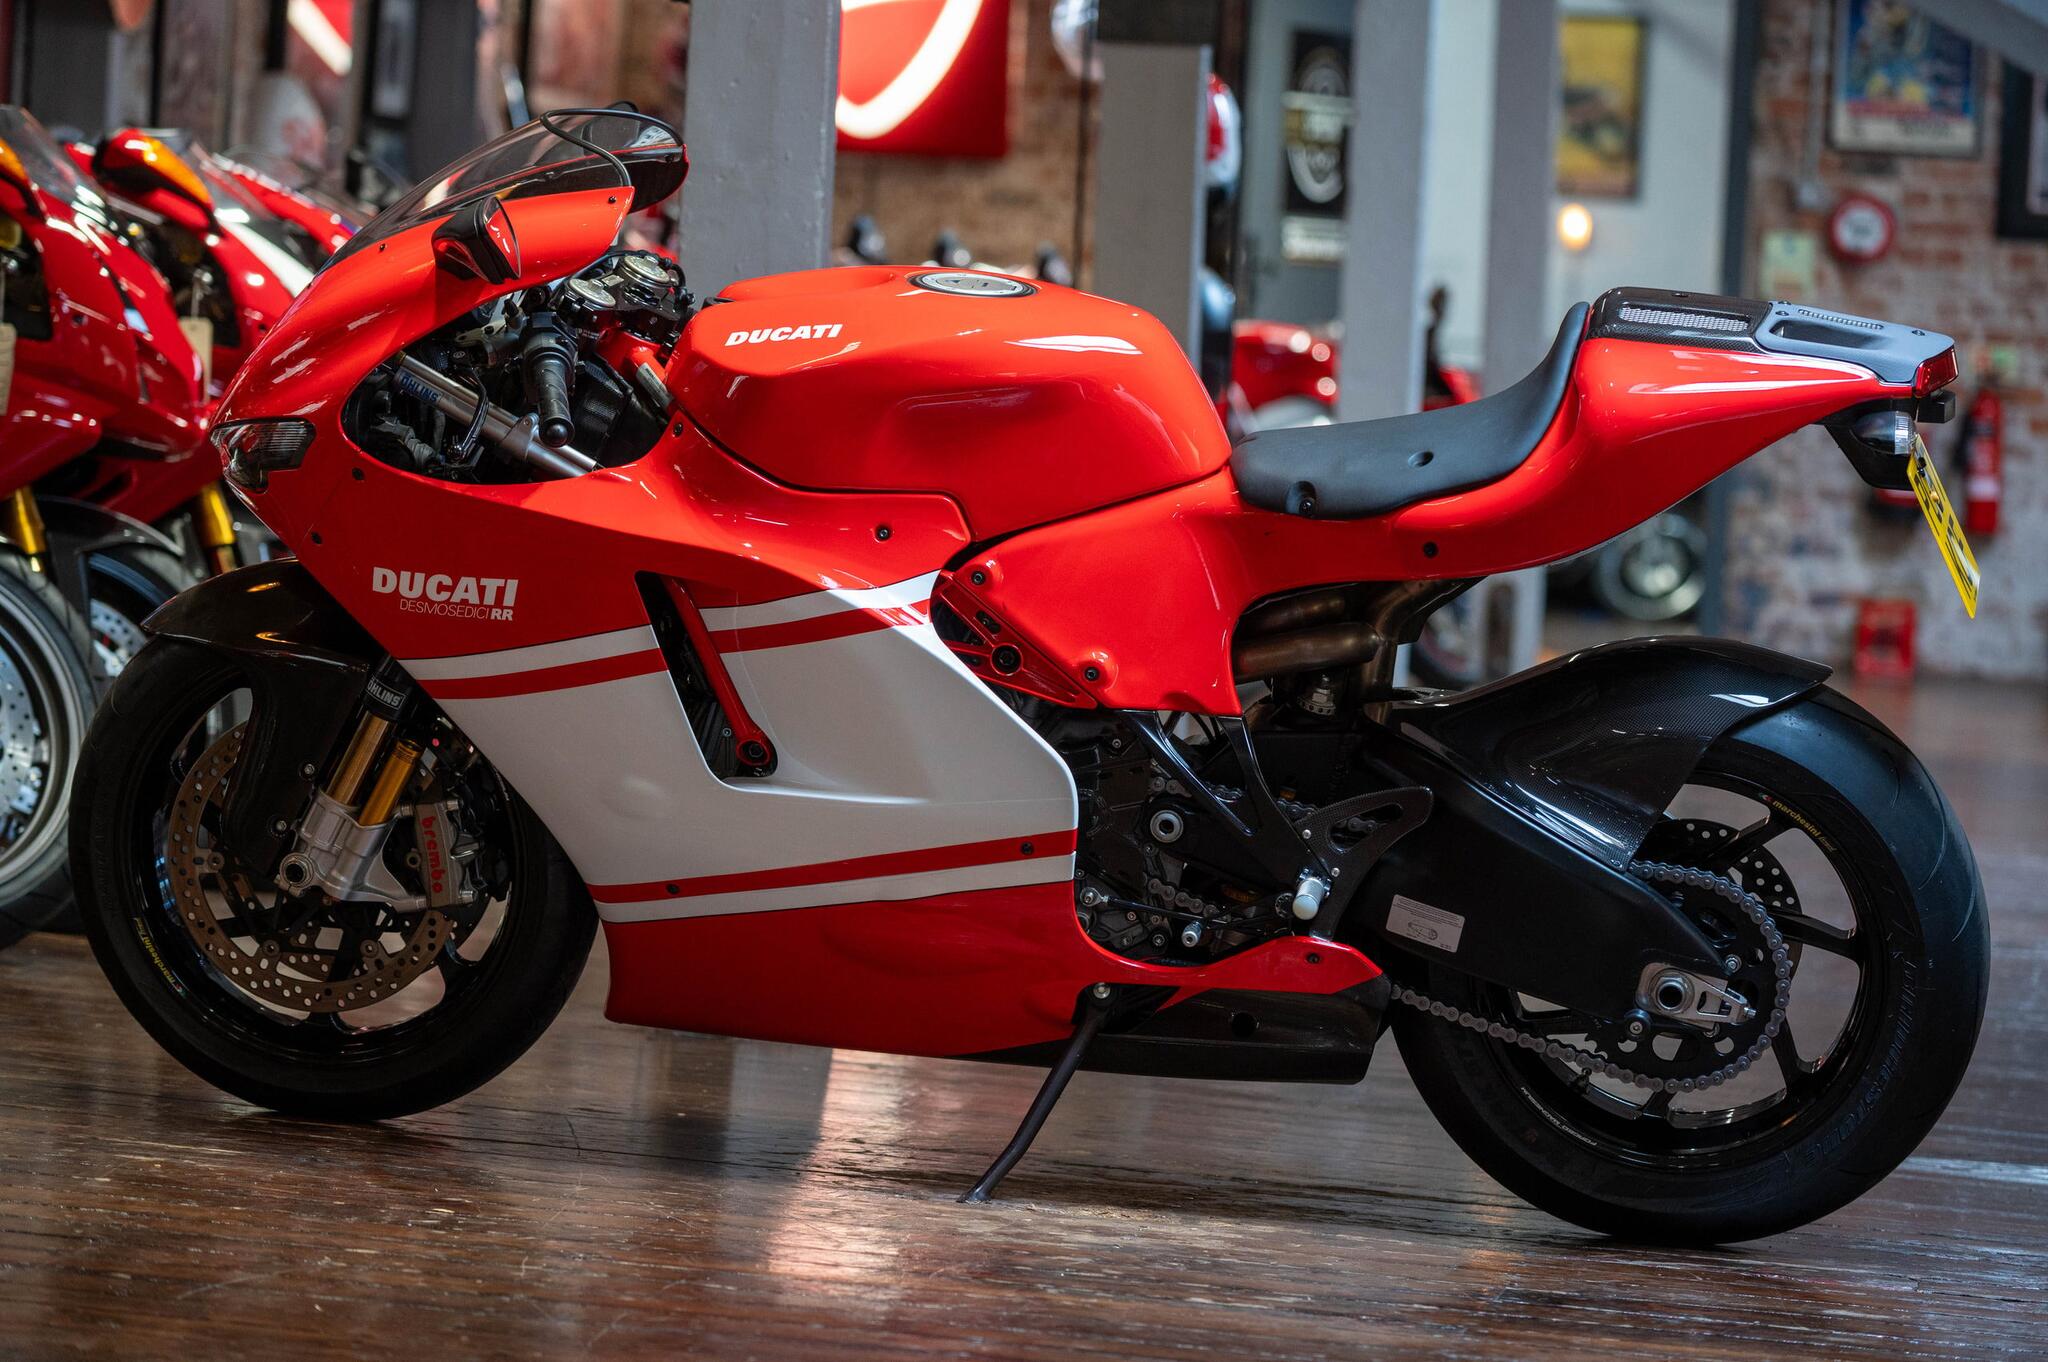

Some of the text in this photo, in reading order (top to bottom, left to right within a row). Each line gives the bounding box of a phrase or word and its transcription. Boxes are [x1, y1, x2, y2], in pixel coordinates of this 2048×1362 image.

[724, 324, 843, 347] DUCATI
[372, 566, 519, 607] DUCATI
[400, 598, 513, 621] DESMOSEDICI RR
[1772, 800, 1822, 837] marchesini
[421, 815, 446, 894] brembo
[142, 936, 176, 984] marchesini
